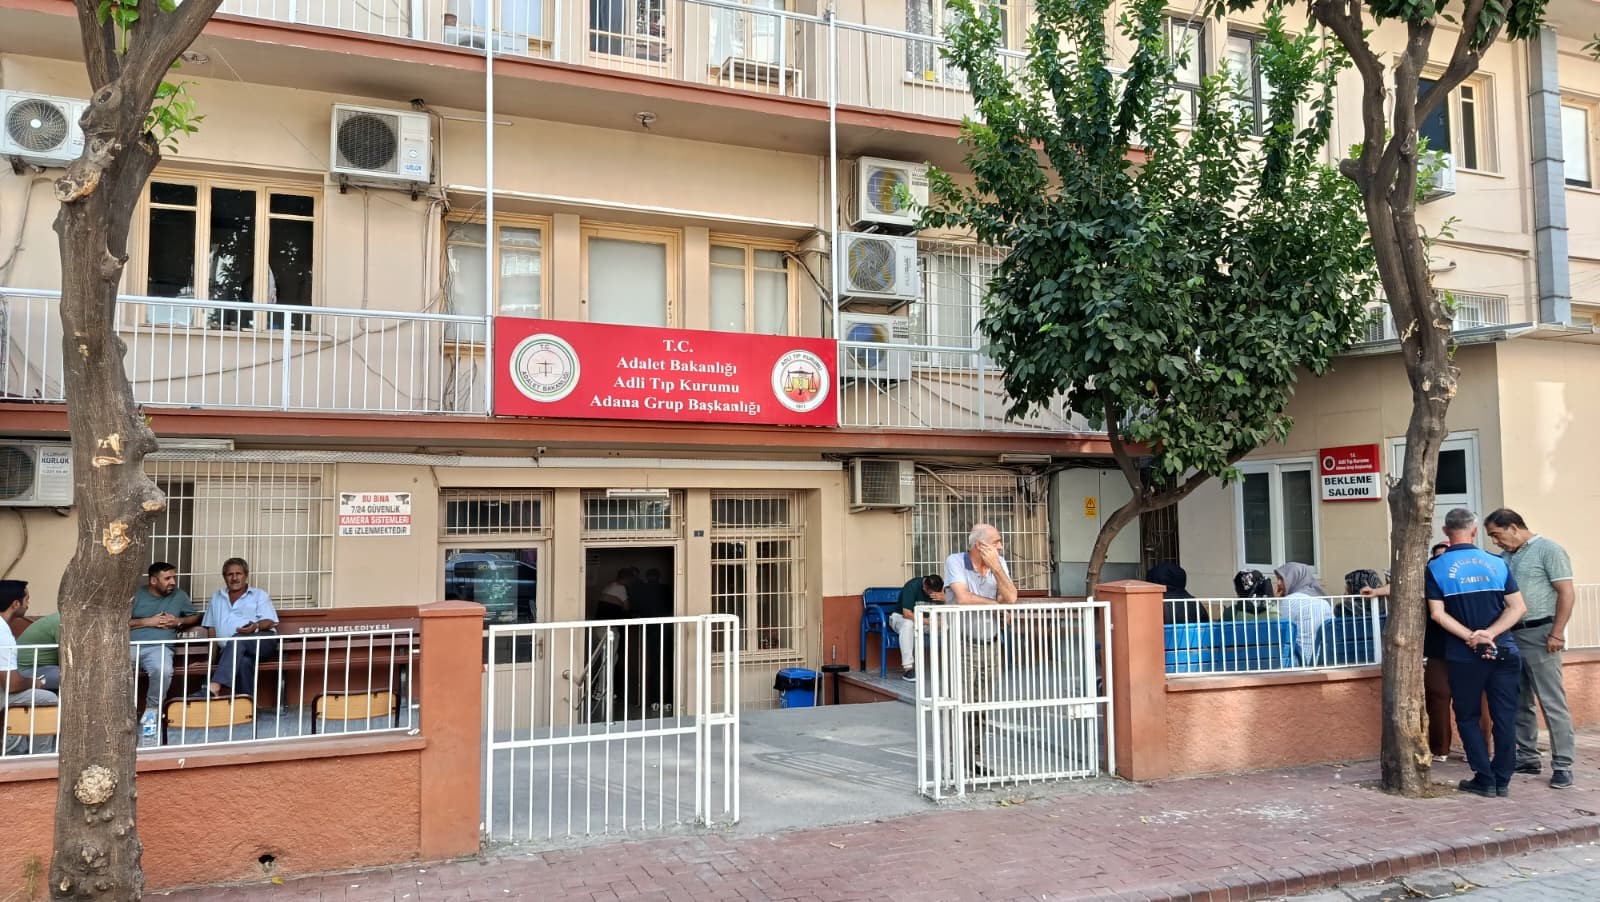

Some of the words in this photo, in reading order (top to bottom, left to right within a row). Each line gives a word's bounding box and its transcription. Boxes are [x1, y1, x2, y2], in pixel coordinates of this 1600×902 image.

[663, 339, 693, 352] T.C.
[616, 357, 665, 371] Adalet
[670, 359, 737, 377] Bakanlığı
[613, 376, 645, 389] Adli
[649, 377, 675, 393] Tıp
[679, 379, 740, 393] Kurumu
[590, 395, 640, 409] Adana
[644, 397, 683, 413] Grup
[688, 399, 761, 415] Başkanlığı
[1324, 475, 1373, 485] BEKLEME
[1328, 487, 1369, 496] SALONU
[351, 505, 365, 513] 7/24
[342, 516, 369, 524] KAMERA
